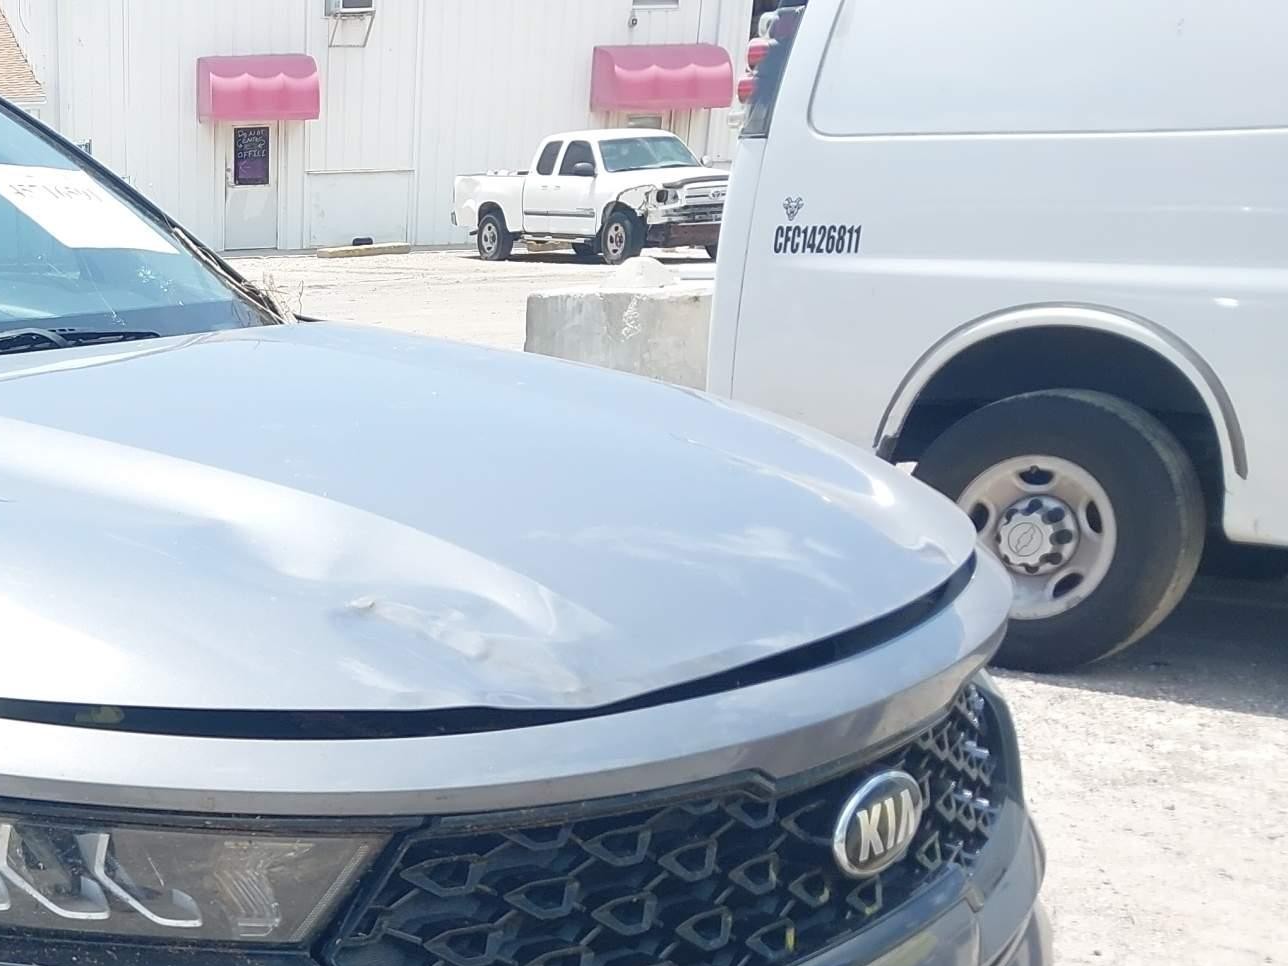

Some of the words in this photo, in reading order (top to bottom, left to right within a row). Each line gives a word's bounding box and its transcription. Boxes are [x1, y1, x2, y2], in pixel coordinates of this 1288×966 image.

[237, 149, 265, 159] OFFICE
[773, 224, 862, 254] CFC1426811
[856, 789, 916, 863] KIA
